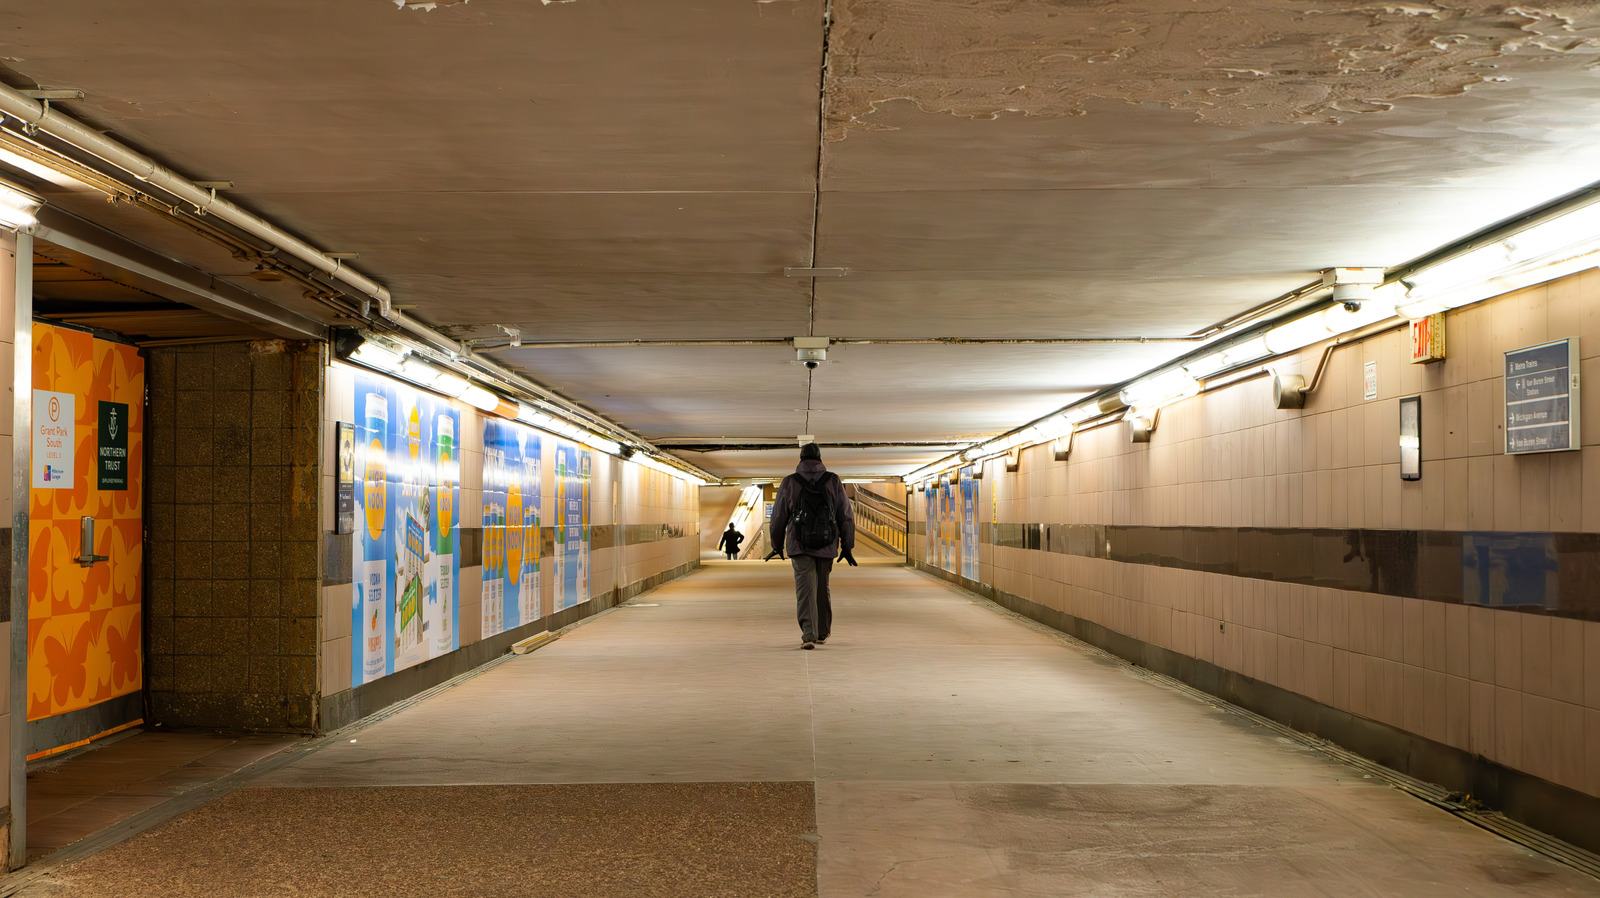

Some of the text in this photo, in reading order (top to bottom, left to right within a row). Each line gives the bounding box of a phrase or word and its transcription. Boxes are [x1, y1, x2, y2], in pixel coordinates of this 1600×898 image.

[1413, 318, 1429, 359] EXIT
[1526, 360, 1538, 369] Trains
[1544, 376, 1555, 384] Street
[52, 401, 58, 417] P
[1516, 411, 1548, 422] Michigan Avenue
[40, 424, 68, 437] Grant Park
[46, 438, 62, 448] South
[1536, 437, 1548, 446] Street
[100, 446, 126, 458] NORTHERN
[105, 460, 120, 470] TRUST
[368, 470, 384, 488] HIGH
[368, 492, 384, 510] NOON
[440, 496, 450, 512] NOON
[509, 505, 521, 525] HIGH
[508, 530, 521, 550] NOON
[370, 572, 381, 586] VODKA
[368, 588, 382, 602] SELTZER
